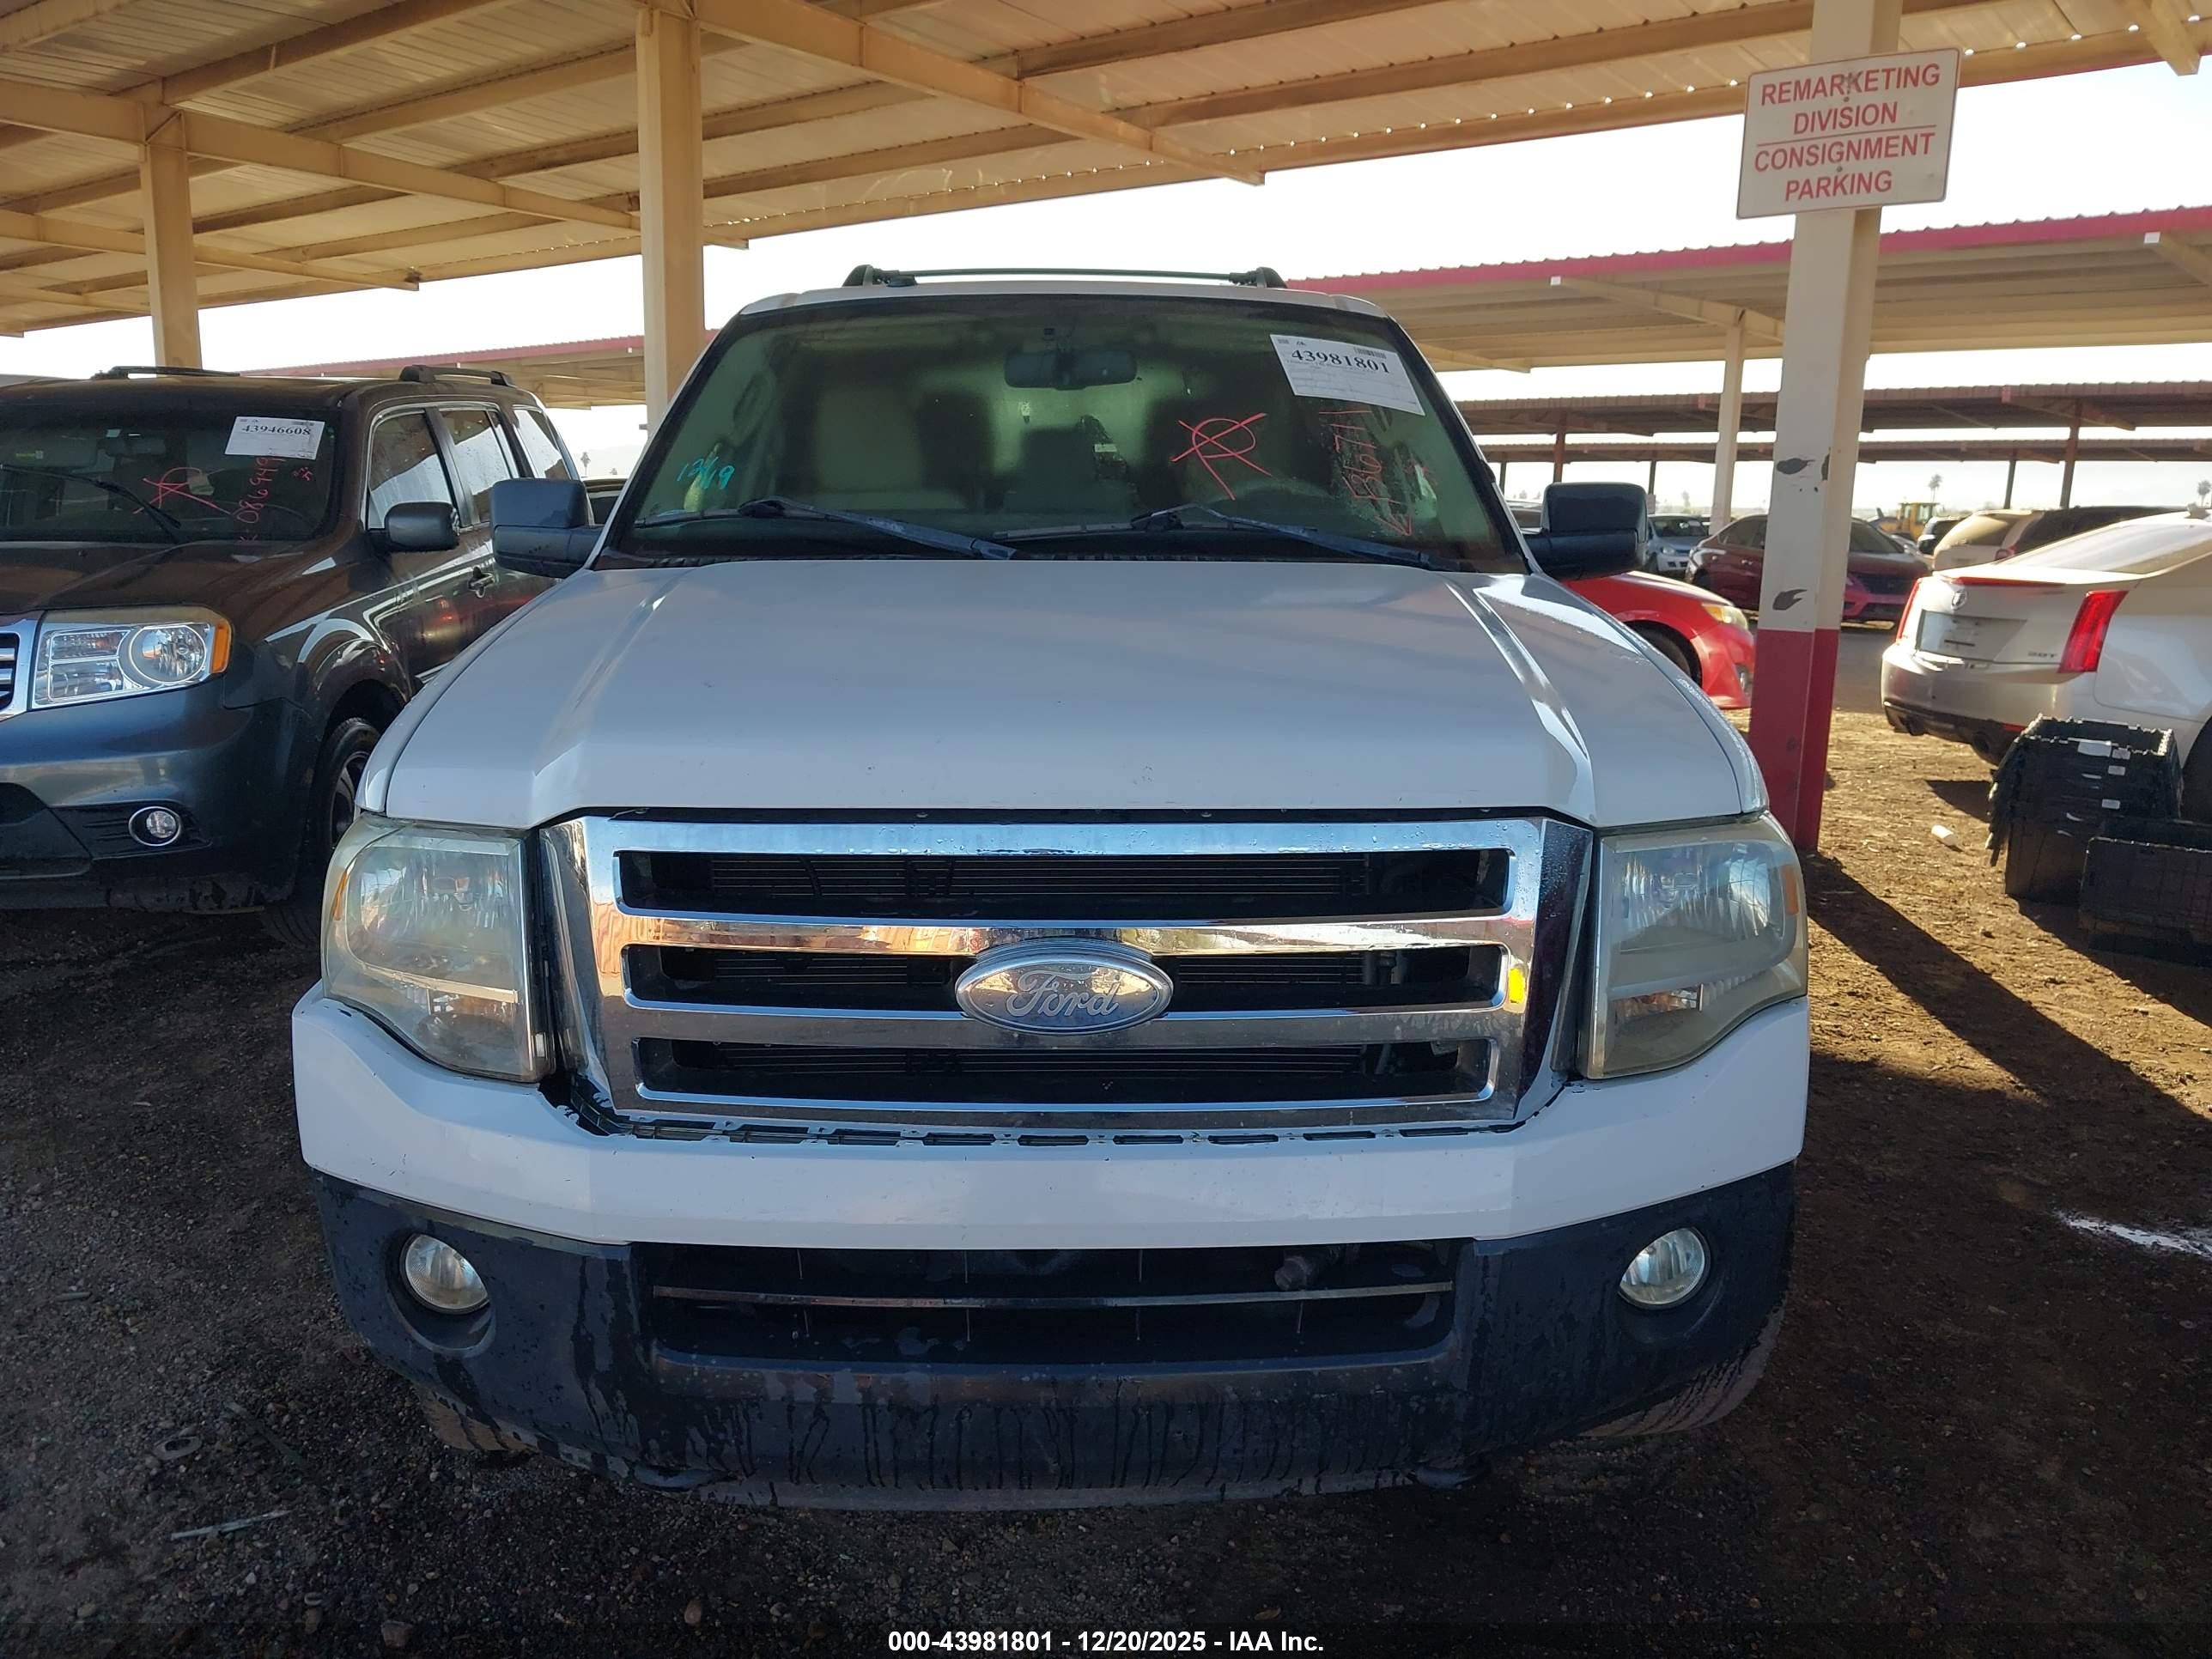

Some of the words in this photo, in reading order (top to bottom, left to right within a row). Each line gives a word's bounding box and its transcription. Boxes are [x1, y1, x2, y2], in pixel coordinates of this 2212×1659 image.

[1760, 63, 1941, 106] REMARKETING
[1793, 101, 1898, 135] DIVISION
[1754, 132, 1936, 172] CONSIGNMENT
[1785, 170, 1893, 201] PARKING
[1291, 349, 1390, 374] 43981801
[240, 424, 312, 435] 43946608
[1006, 969, 1120, 1017] Ford
